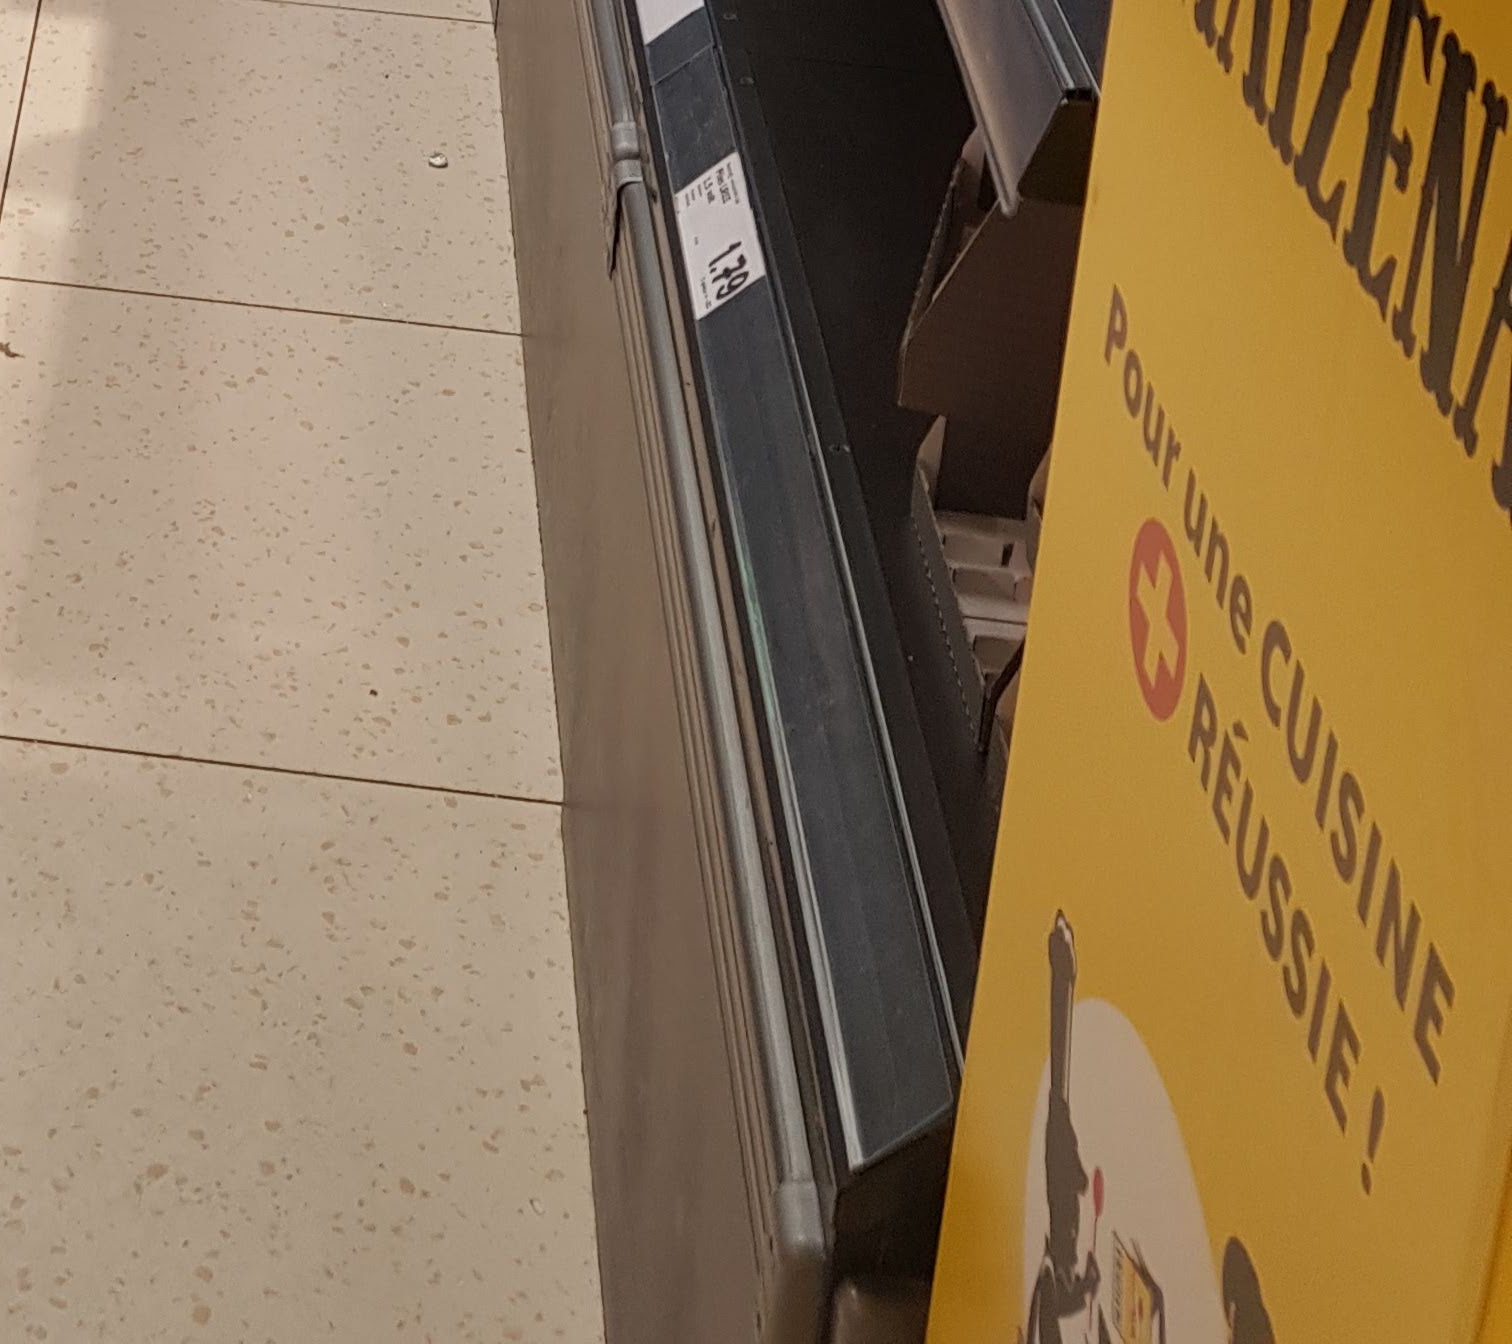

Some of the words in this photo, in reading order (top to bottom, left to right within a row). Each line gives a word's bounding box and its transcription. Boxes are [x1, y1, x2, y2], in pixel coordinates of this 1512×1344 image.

[708, 241, 750, 301] 1.79
[1103, 284, 1181, 490] Pour
[1181, 466, 1254, 656] une
[1259, 618, 1456, 1088] CUISINE
[1187, 670, 1365, 1138] RÉUSSIE
